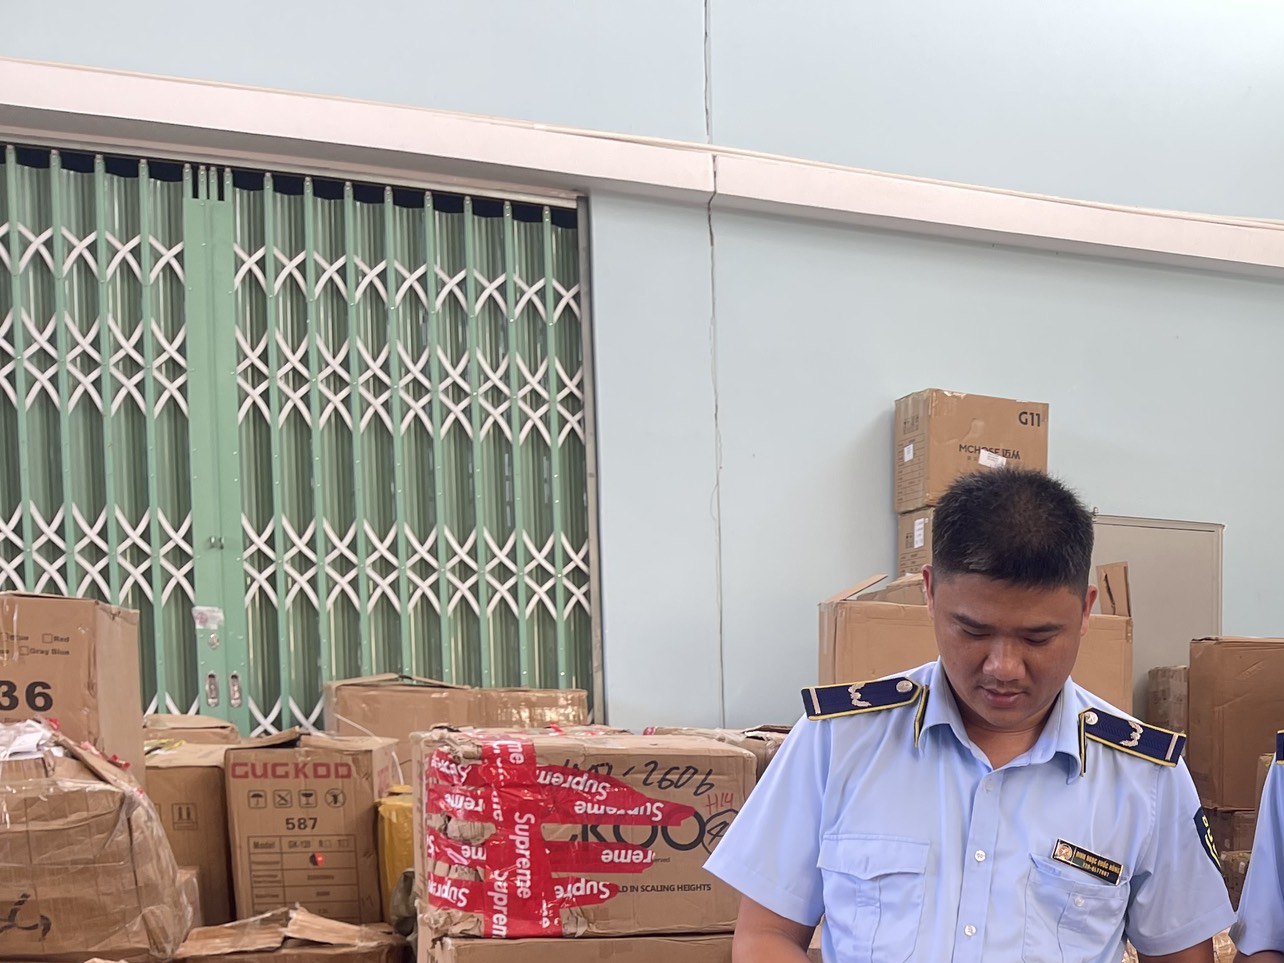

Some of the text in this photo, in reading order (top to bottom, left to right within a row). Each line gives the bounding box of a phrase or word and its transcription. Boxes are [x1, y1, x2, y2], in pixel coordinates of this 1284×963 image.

[1018, 411, 1041, 427] G11
[285, 817, 318, 830] 587
[630, 884, 639, 892] IN
[640, 884, 675, 892] SCALING
[677, 883, 712, 892] HEIGHTS
